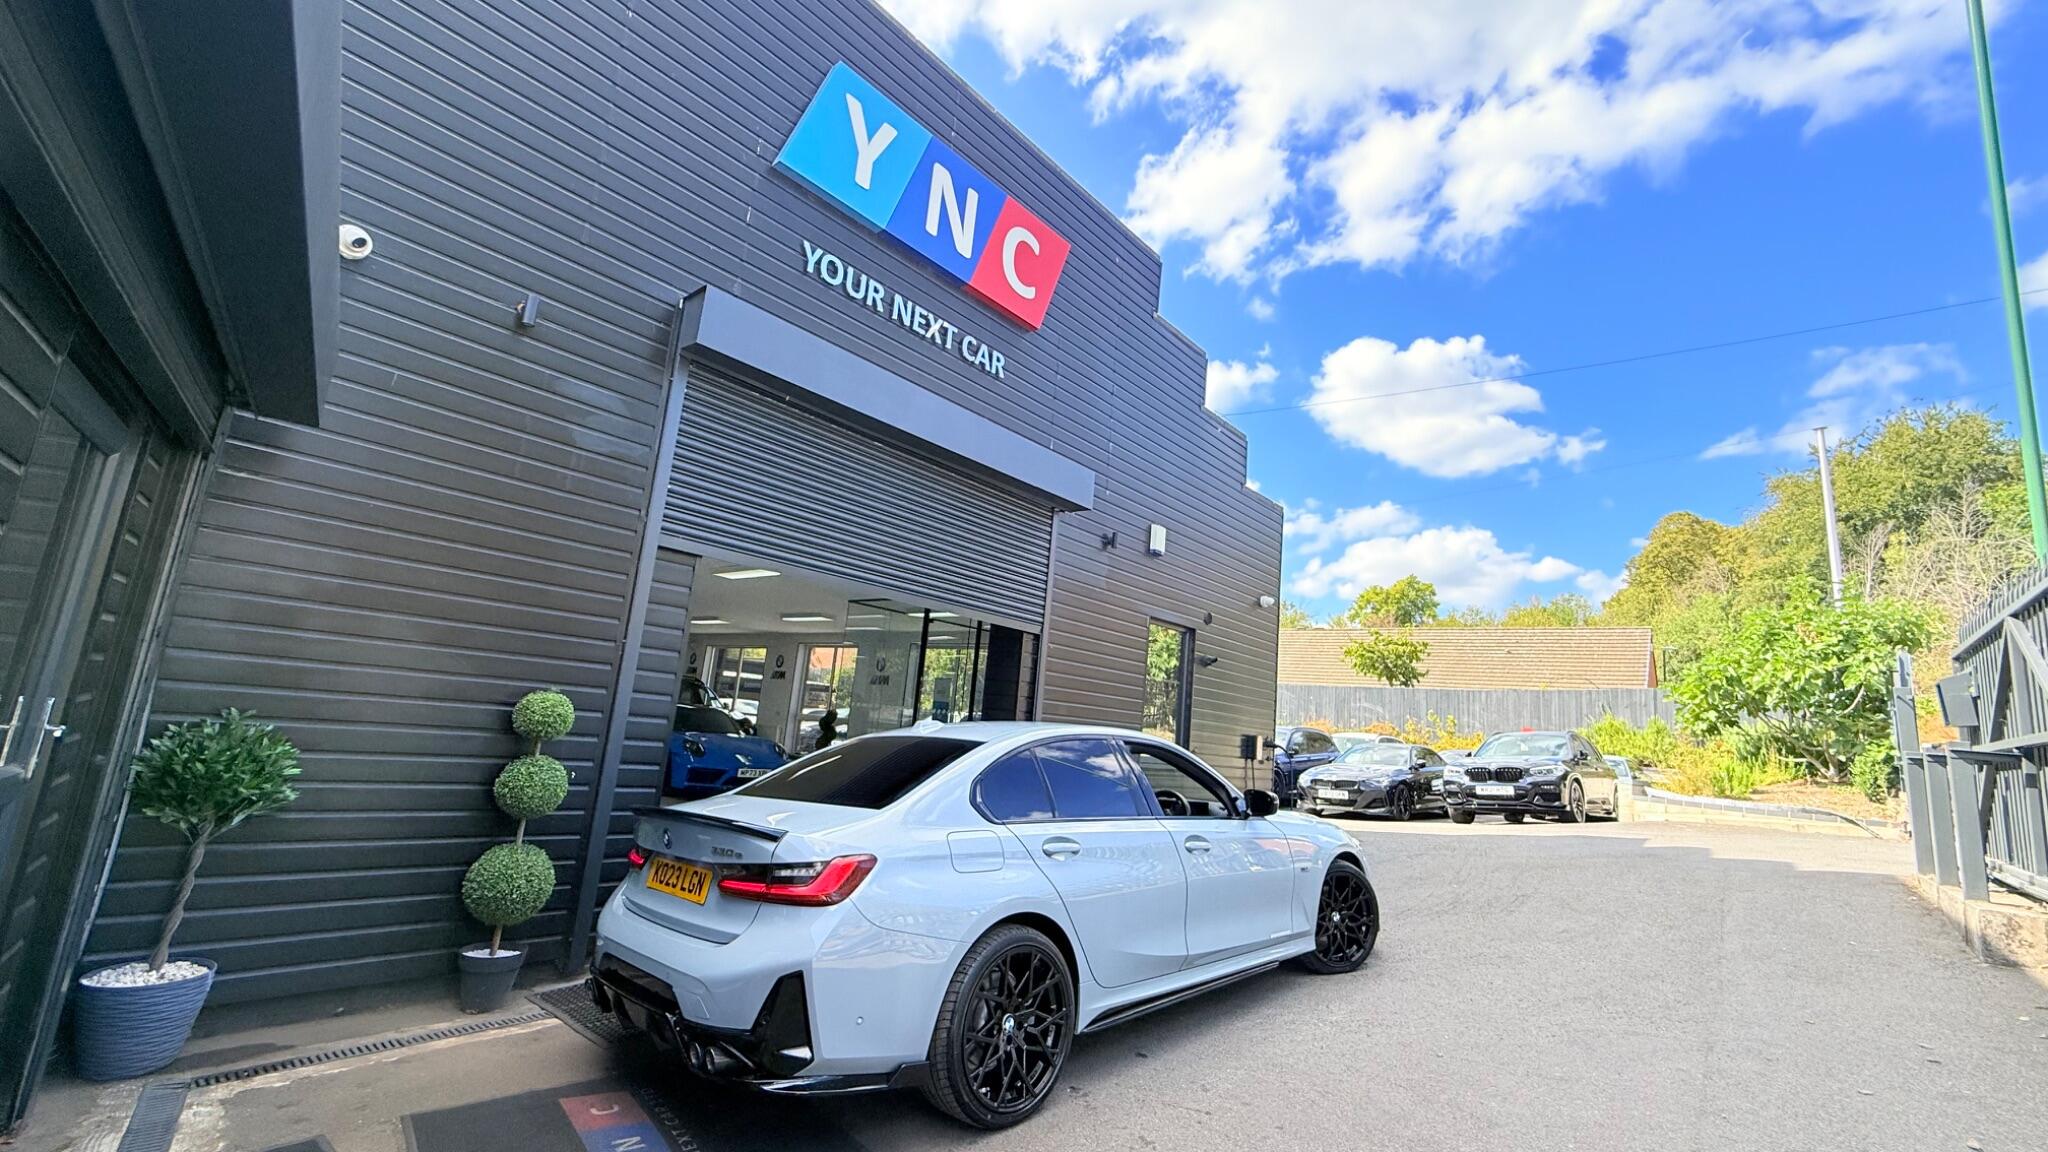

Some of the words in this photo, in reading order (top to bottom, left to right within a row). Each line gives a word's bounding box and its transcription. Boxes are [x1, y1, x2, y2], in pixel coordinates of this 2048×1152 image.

[846, 93, 1039, 299] YNC
[802, 240, 885, 312] YOUR
[893, 294, 958, 349] NEXT
[962, 336, 1006, 378] CAR
[680, 868, 706, 896] LGN
[672, 1128, 700, 1152] EXT
